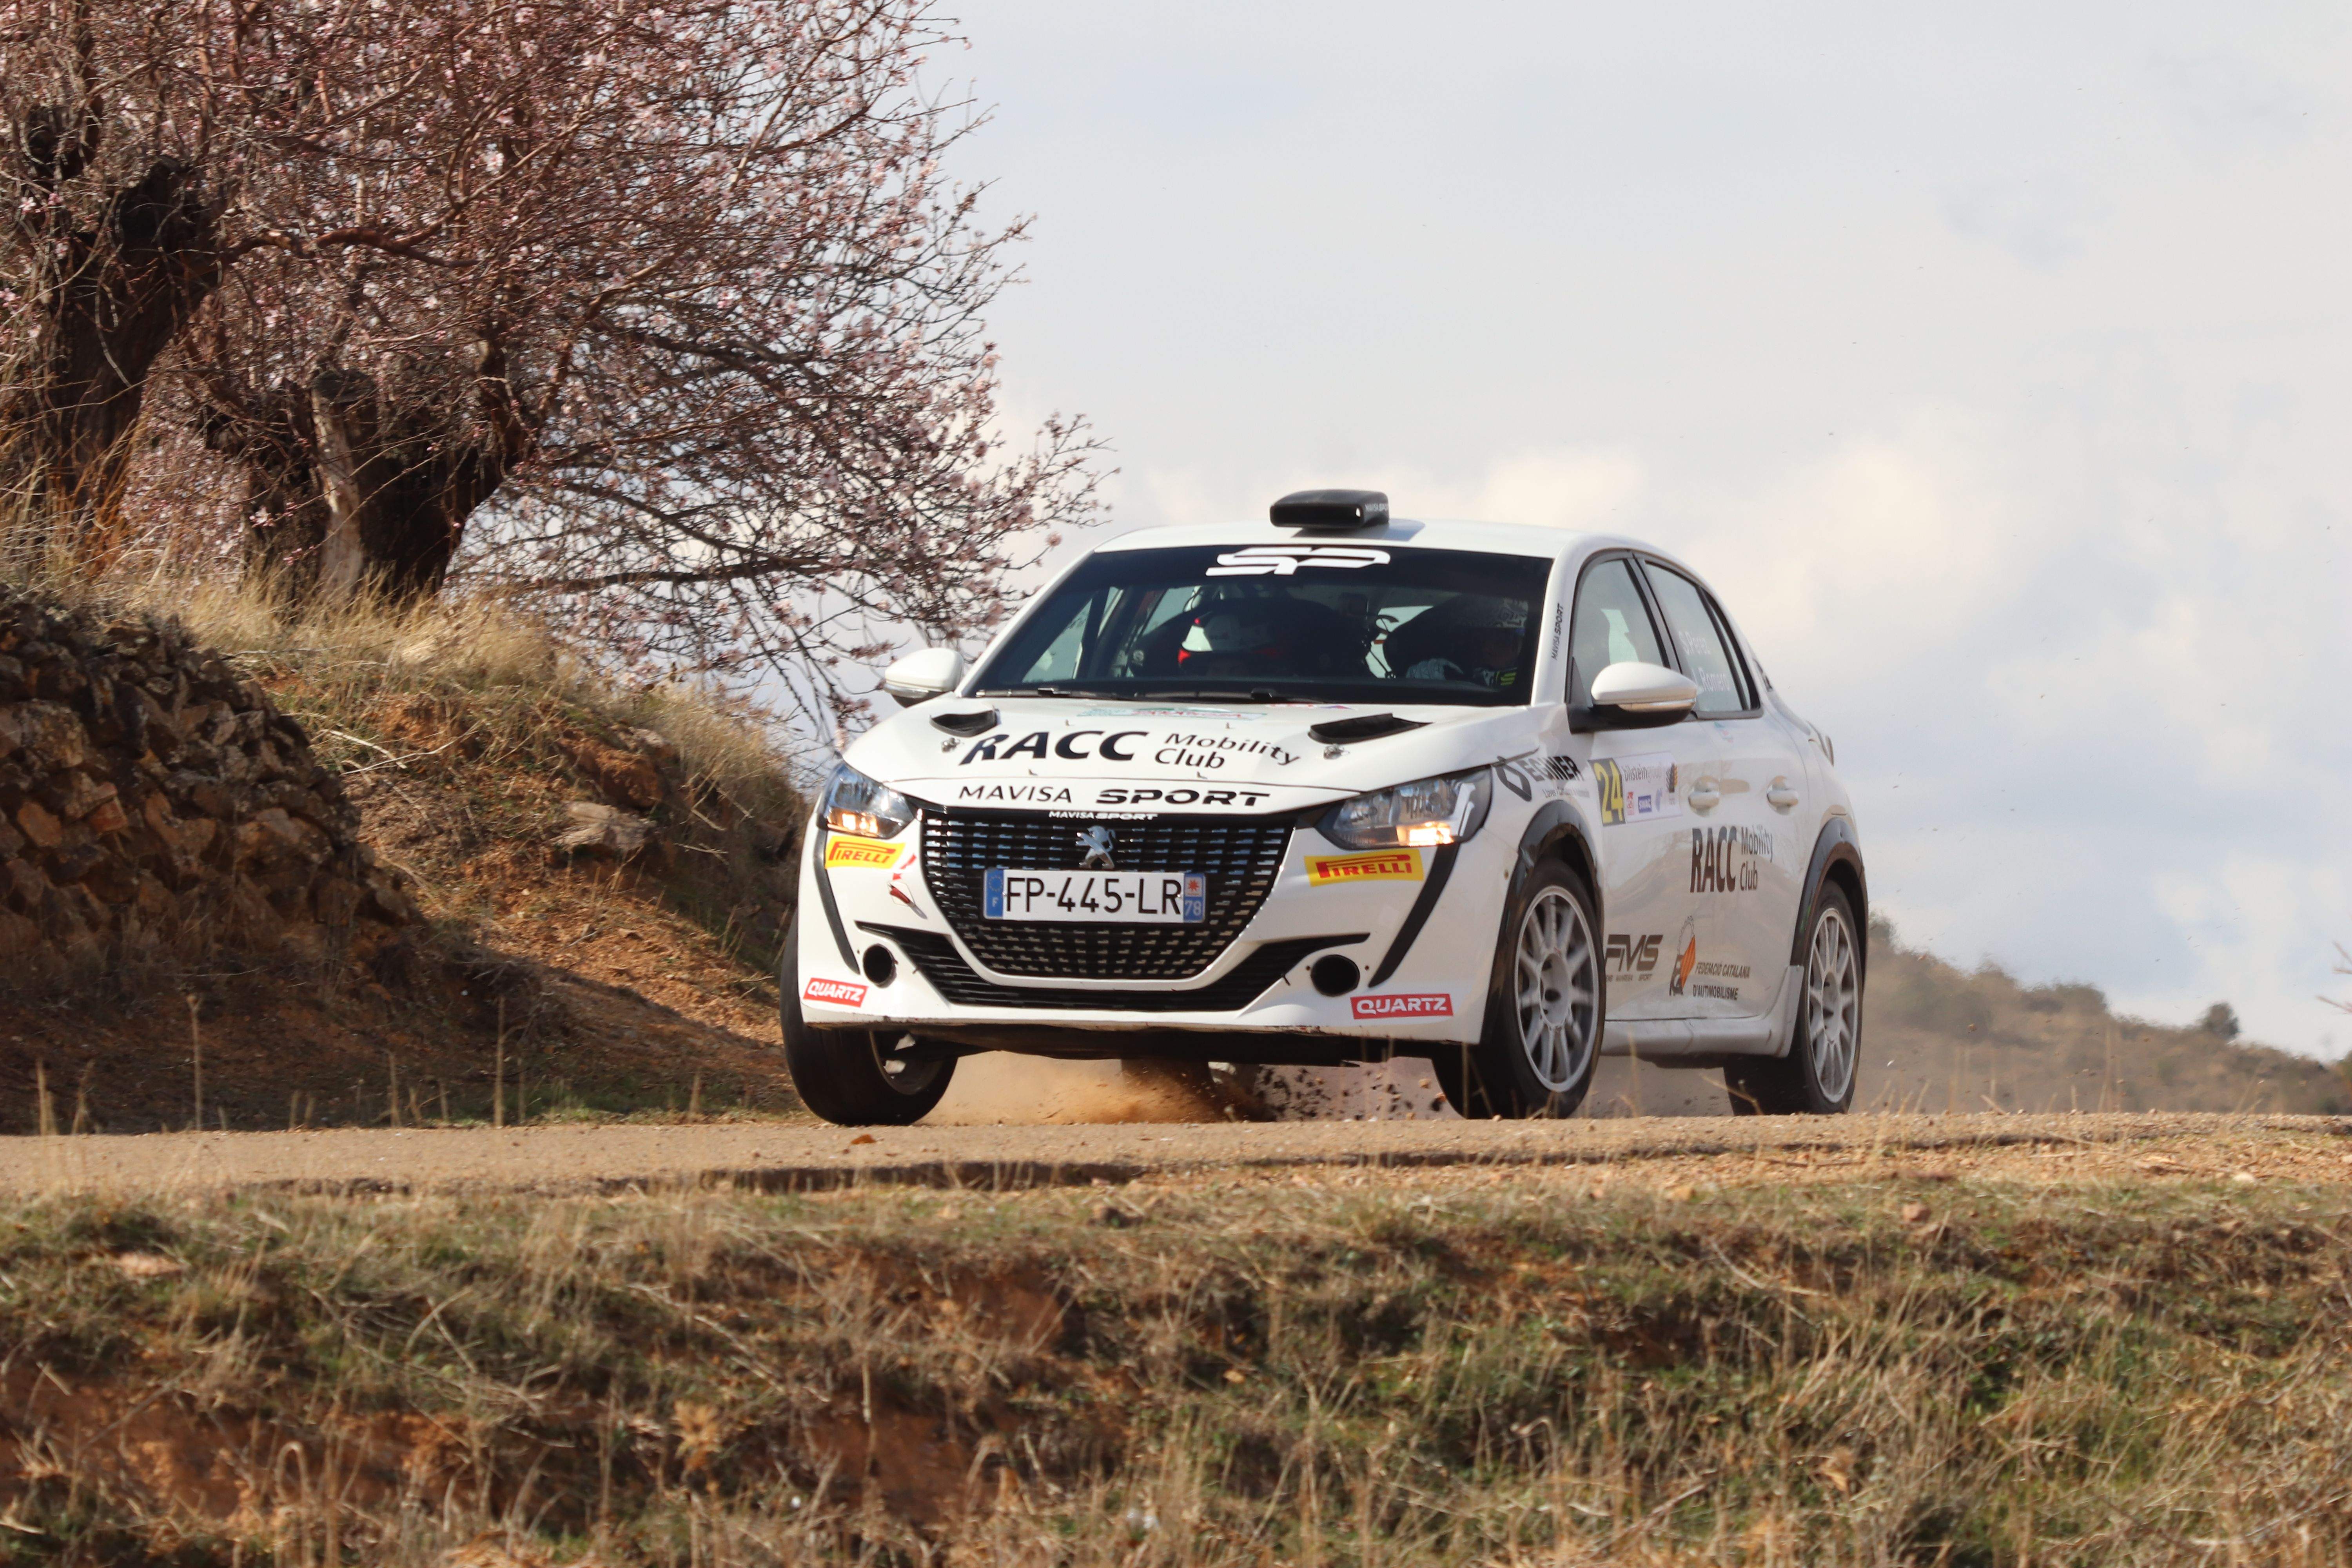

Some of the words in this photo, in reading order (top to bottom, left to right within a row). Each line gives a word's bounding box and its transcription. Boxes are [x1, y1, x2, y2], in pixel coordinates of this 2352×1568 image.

[1554, 603, 1563, 636] SPORT
[1551, 636, 1560, 661] MAVISA
[959, 731, 1149, 766] RACC
[1165, 733, 1301, 766] Mobility
[1154, 748, 1225, 769] Club
[959, 785, 1073, 804] MAVISA
[1096, 789, 1270, 807] SPORT
[1593, 761, 1624, 824] 24
[1049, 811, 1094, 819] MAVISA
[1095, 812, 1158, 820] SPORT
[828, 841, 896, 864] PIRELLI
[1690, 826, 1737, 893] RACC
[1741, 824, 1773, 863] Mobility
[1316, 854, 1412, 878] PIRELLI
[1740, 861, 1758, 891] Club
[992, 897, 999, 907] F
[1006, 877, 1181, 915] FP-445-LR
[1184, 900, 1201, 916] 78
[1722, 964, 1750, 979] CATALANA
[807, 981, 864, 1002] QUARTZ
[1356, 997, 1447, 1015] QUARTZ
